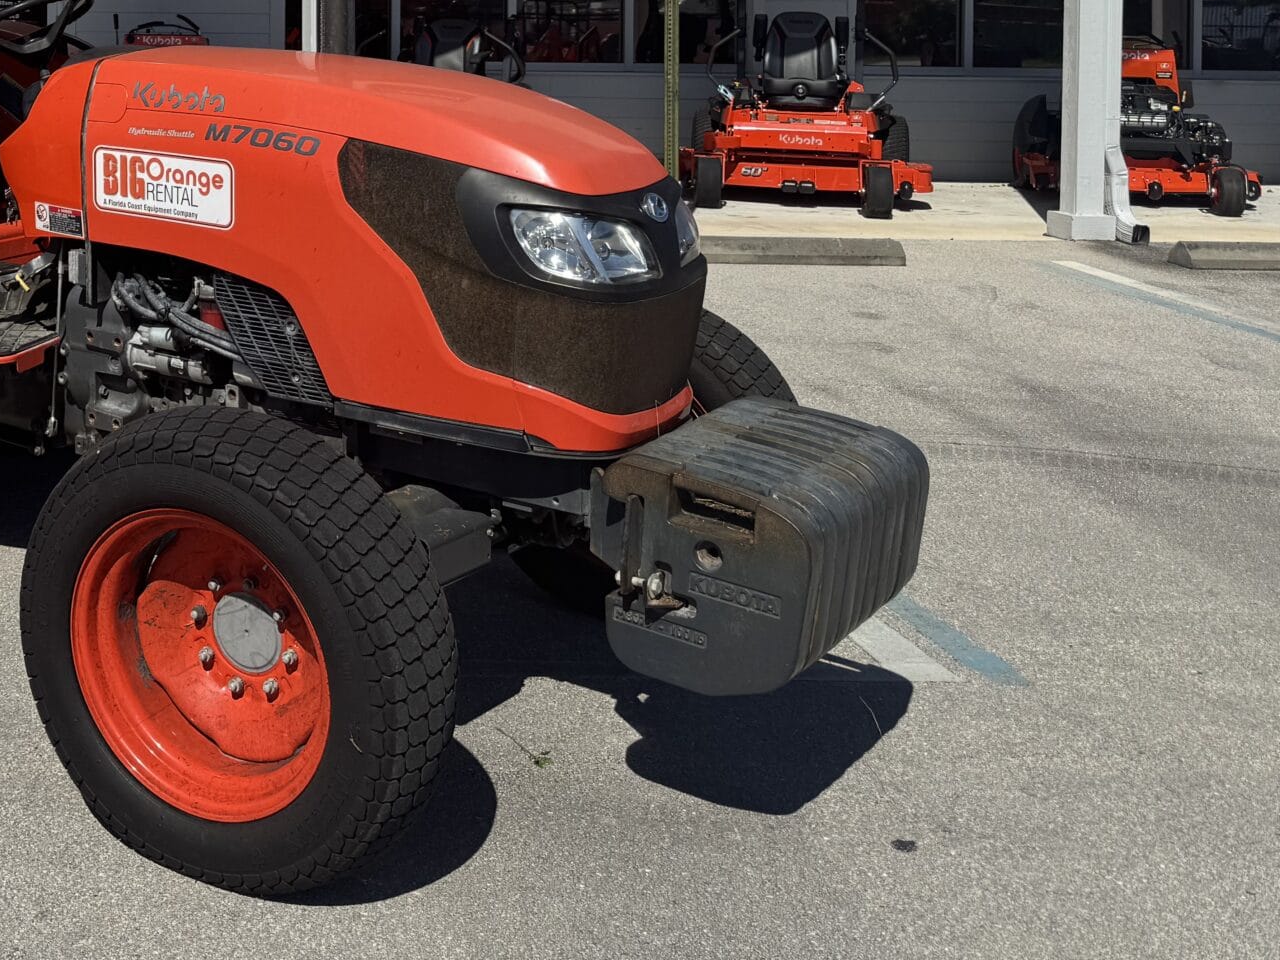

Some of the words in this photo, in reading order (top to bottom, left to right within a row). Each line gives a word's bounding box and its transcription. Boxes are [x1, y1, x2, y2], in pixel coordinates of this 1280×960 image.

[142, 35, 182, 45] Kubota
[132, 80, 225, 113] Kubota
[128, 126, 167, 137] Hydraulic
[166, 129, 195, 138] Shuttle
[204, 123, 321, 156] M7060
[779, 133, 823, 146] Kubota
[103, 152, 146, 200] BIG
[146, 157, 224, 196] Orange
[108, 199, 126, 208] Florida
[127, 201, 143, 210] Coast
[143, 204, 172, 214] Equipment
[173, 208, 198, 219] Company
[146, 182, 199, 208] RENTAL
[692, 577, 780, 617] KUBOTA
